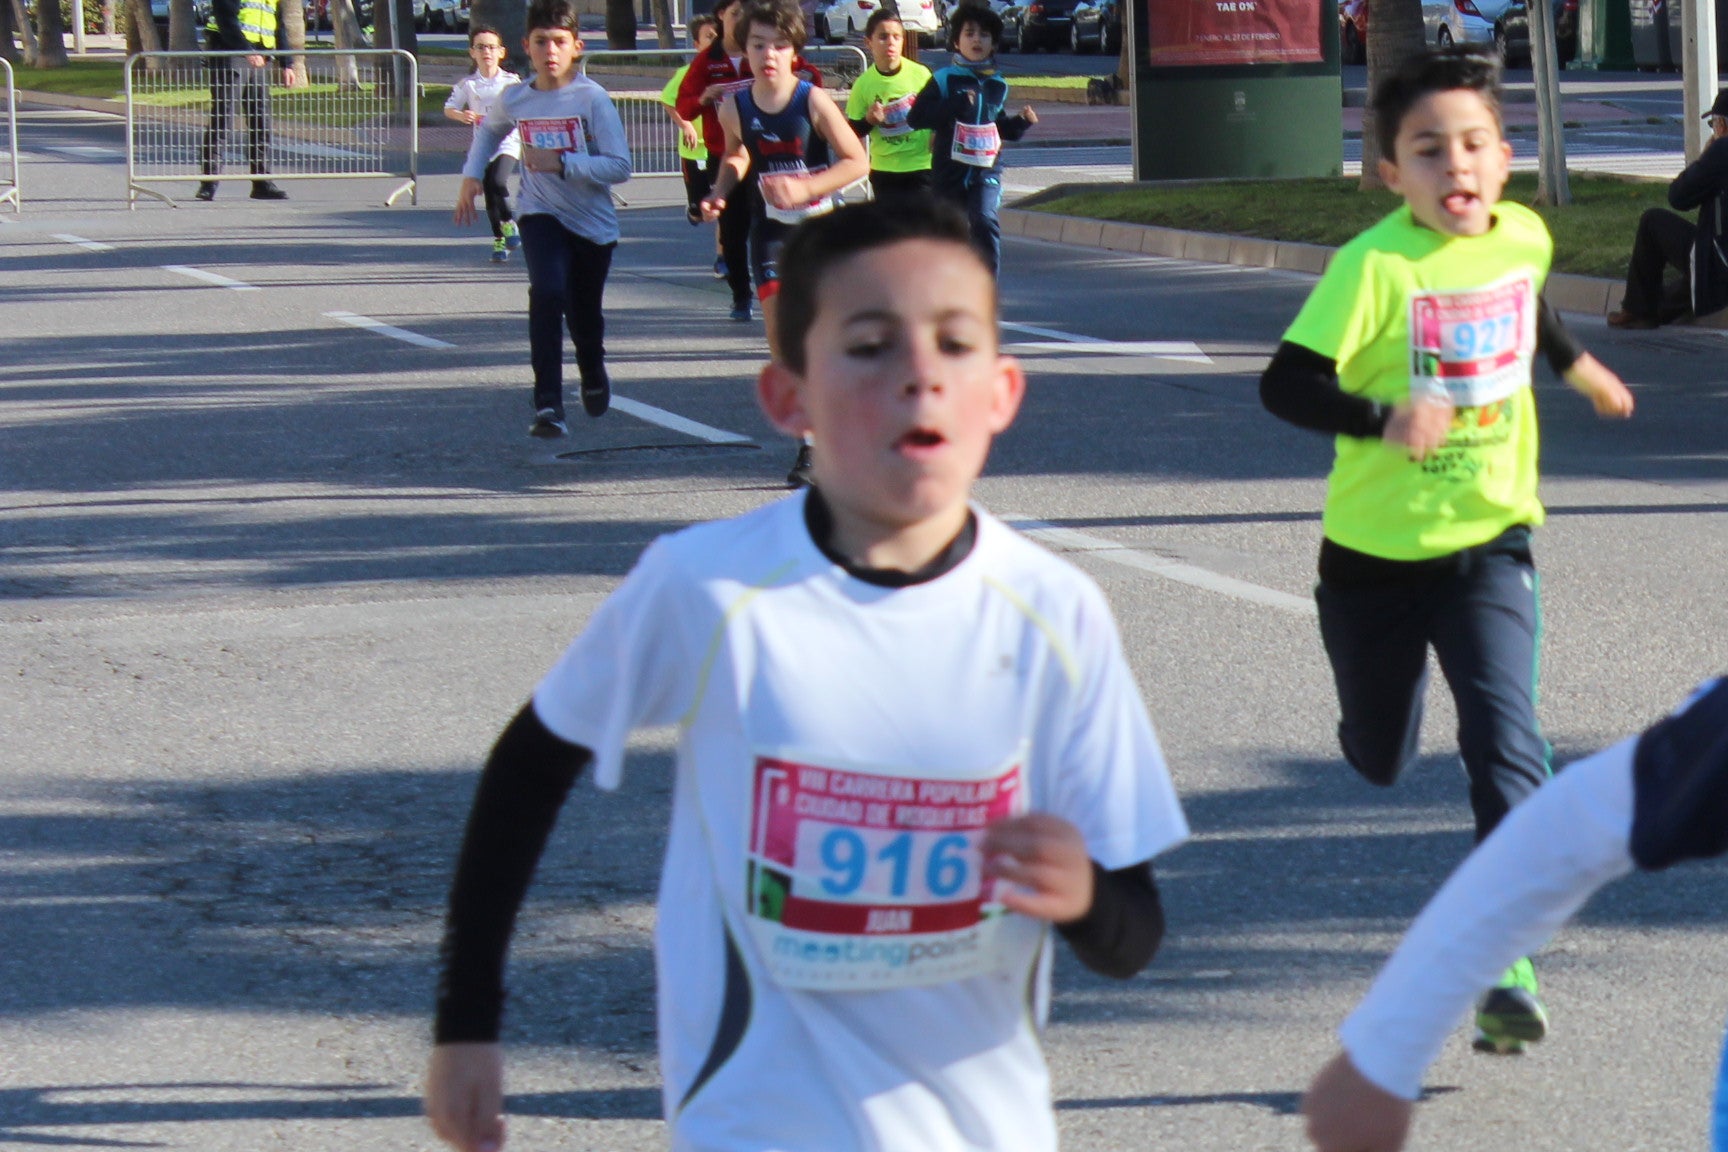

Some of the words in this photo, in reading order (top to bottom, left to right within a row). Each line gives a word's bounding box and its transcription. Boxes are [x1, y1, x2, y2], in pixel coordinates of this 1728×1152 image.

[1216, 2, 1236, 11] TAE
[535, 132, 566, 148] 951
[820, 827, 970, 897] 916
[865, 909, 912, 933] JUAN
